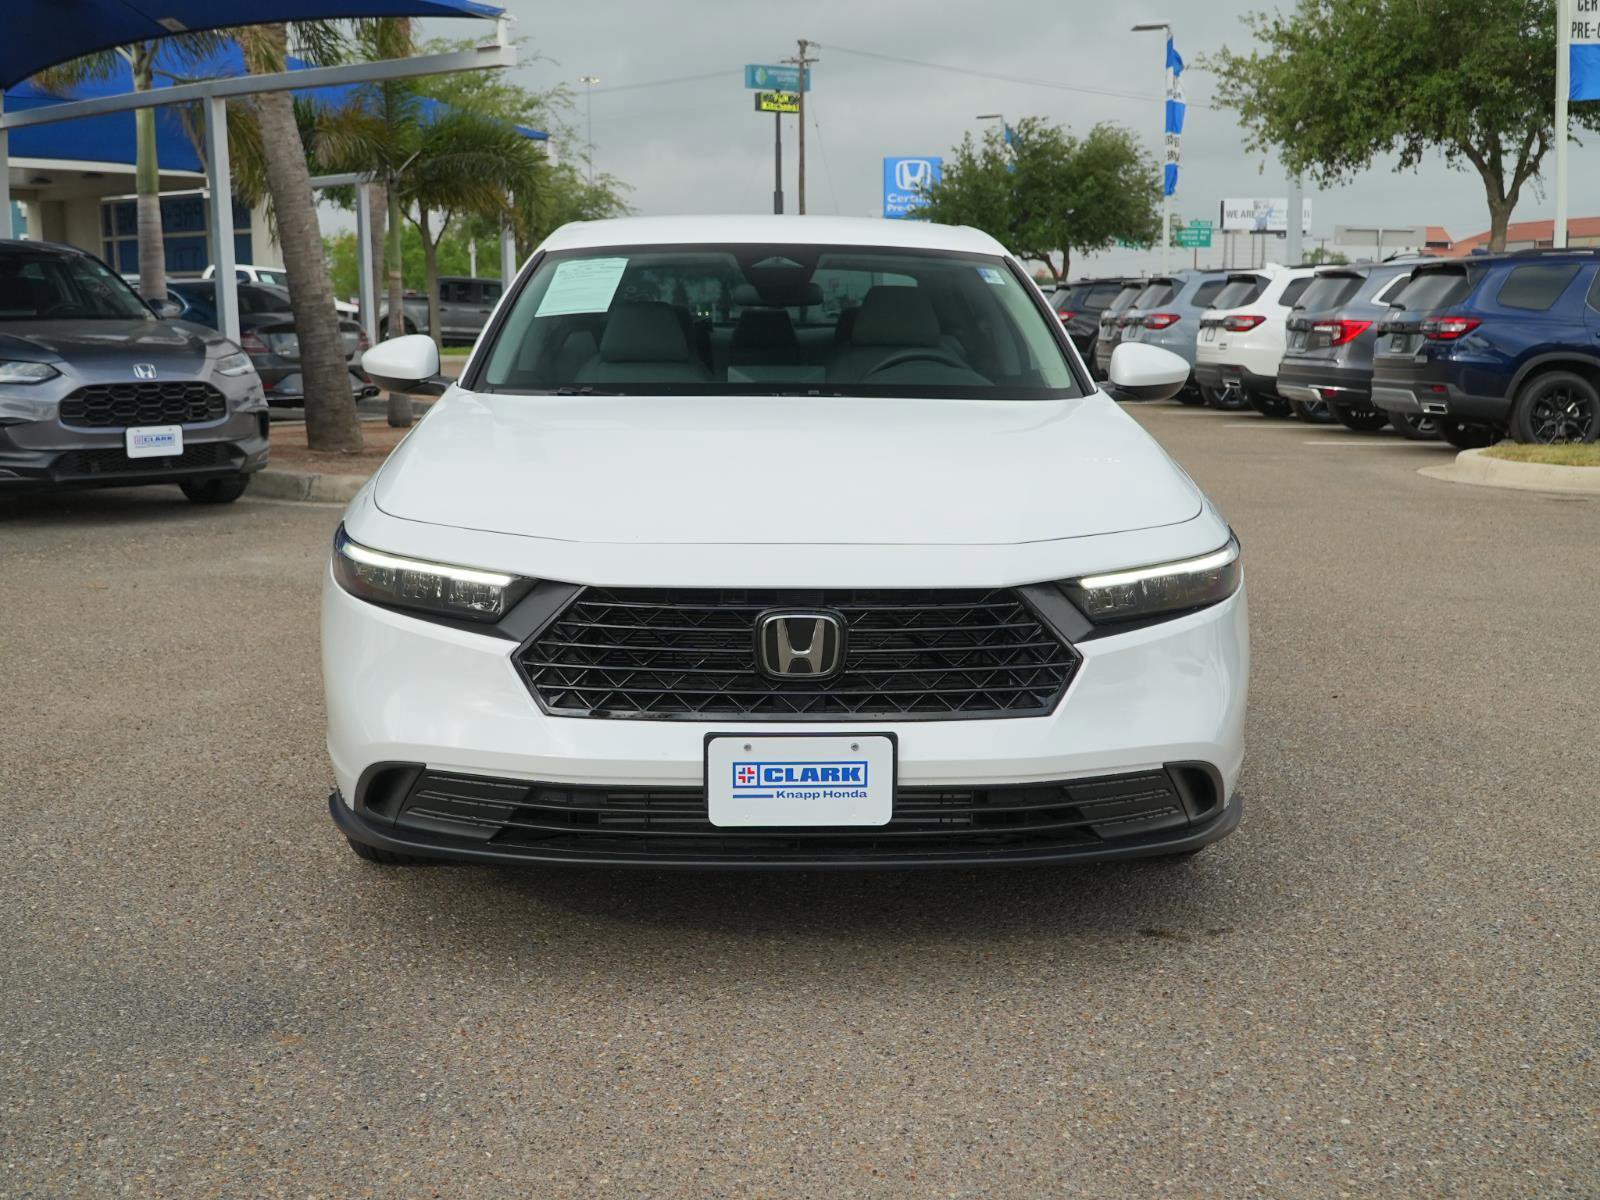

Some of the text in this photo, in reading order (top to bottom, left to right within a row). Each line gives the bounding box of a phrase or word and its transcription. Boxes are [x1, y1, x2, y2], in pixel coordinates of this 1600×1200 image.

[887, 193, 936, 204] Certi
[1226, 210, 1239, 219] WE
[763, 767, 861, 783] CLARK
[776, 789, 867, 801] Knapp Honda
